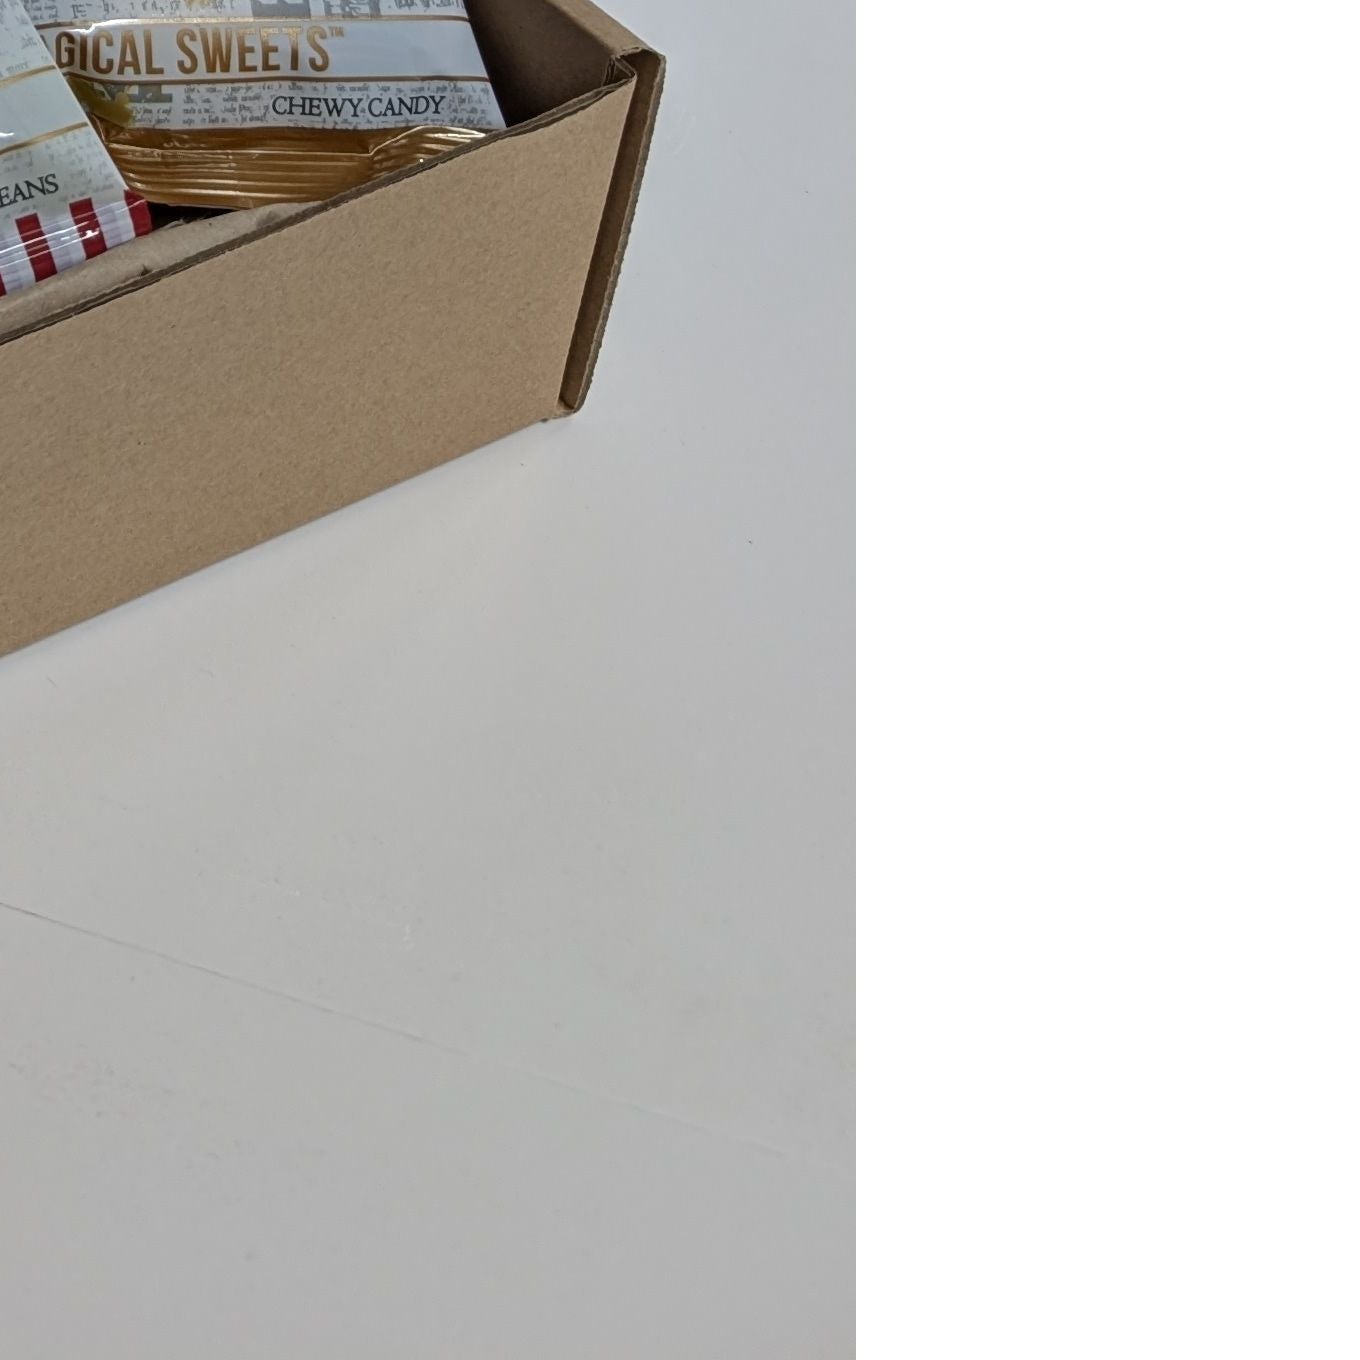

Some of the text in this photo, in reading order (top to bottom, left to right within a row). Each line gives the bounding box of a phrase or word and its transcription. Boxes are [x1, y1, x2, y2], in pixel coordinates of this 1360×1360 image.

[52, 28, 165, 76] GICAL
[271, 95, 364, 118] CHEWY
[367, 94, 447, 118] CANDY
